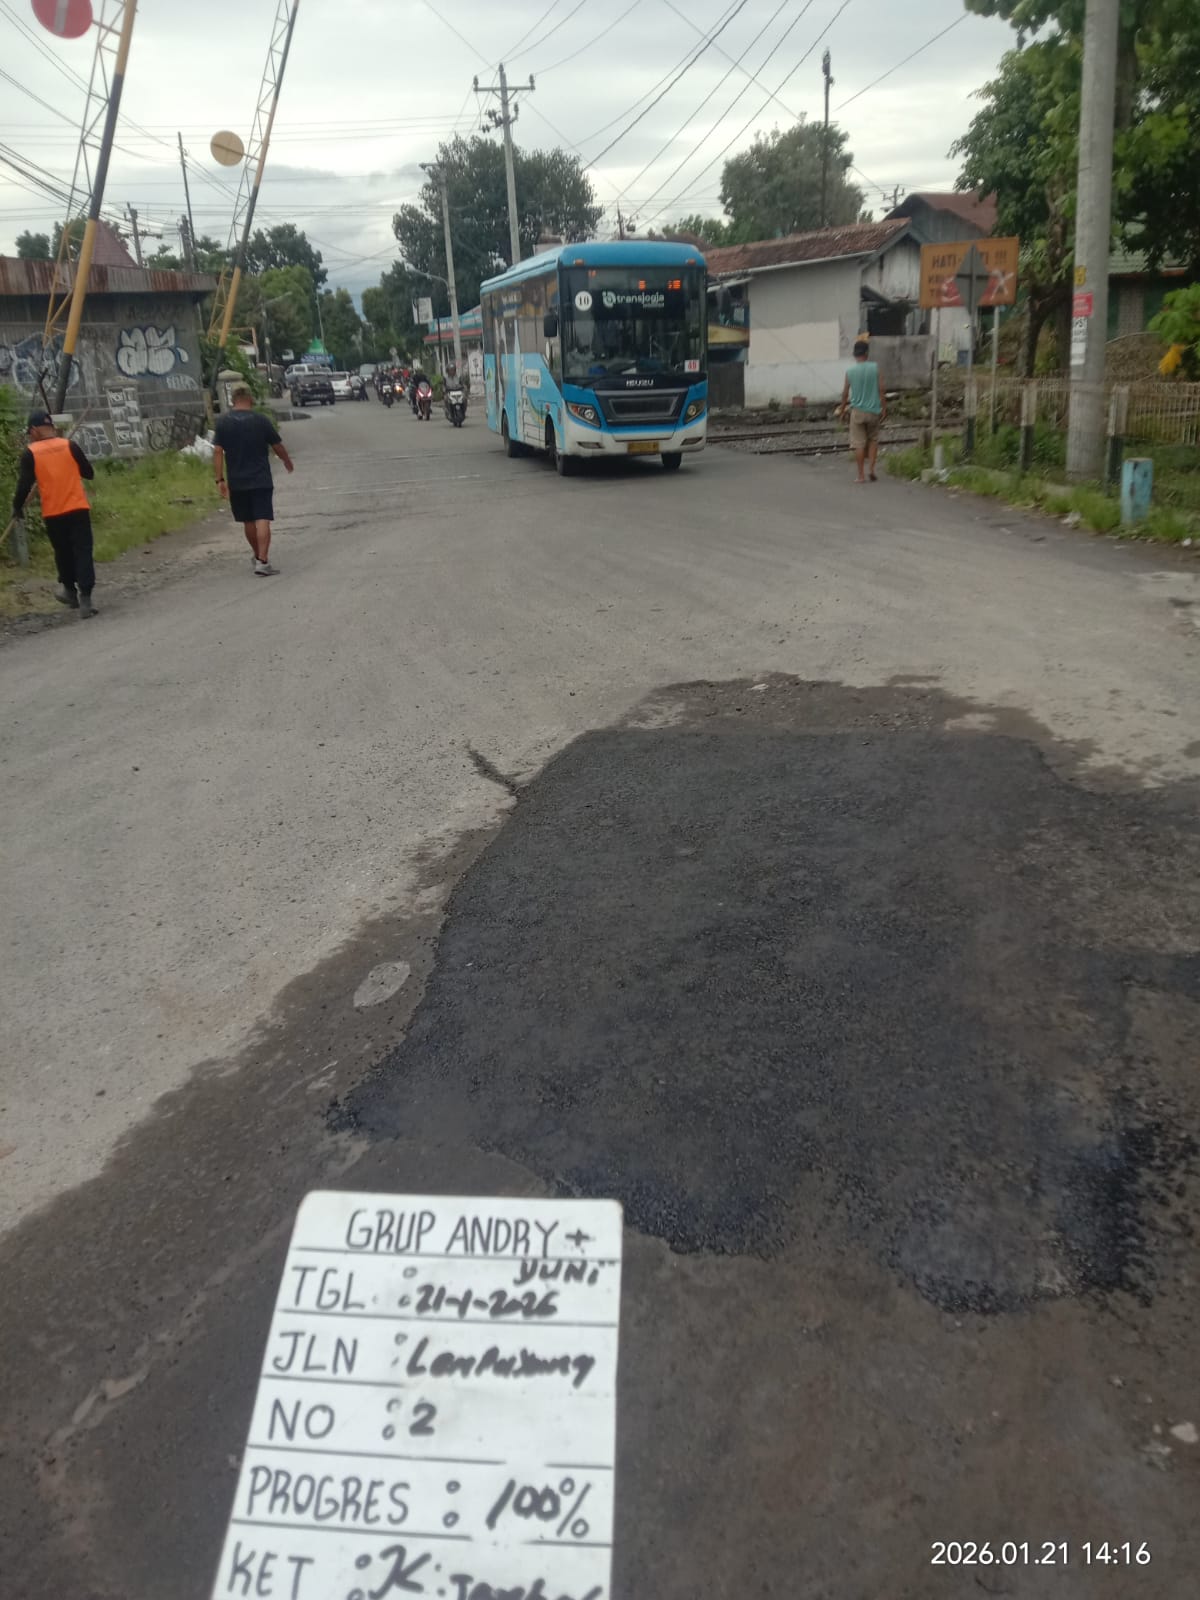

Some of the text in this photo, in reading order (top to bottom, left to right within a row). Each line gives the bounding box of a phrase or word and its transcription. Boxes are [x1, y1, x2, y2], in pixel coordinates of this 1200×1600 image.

[346, 1209, 436, 1252] GRUP
[446, 1216, 559, 1258] ANDRY
[292, 1266, 366, 1310] TGL
[273, 1331, 358, 1374] JLN
[268, 1399, 335, 1441] NO
[246, 1465, 411, 1525] PROGRES
[486, 1477, 592, 1539] 100%
[228, 1541, 314, 1600] KET
